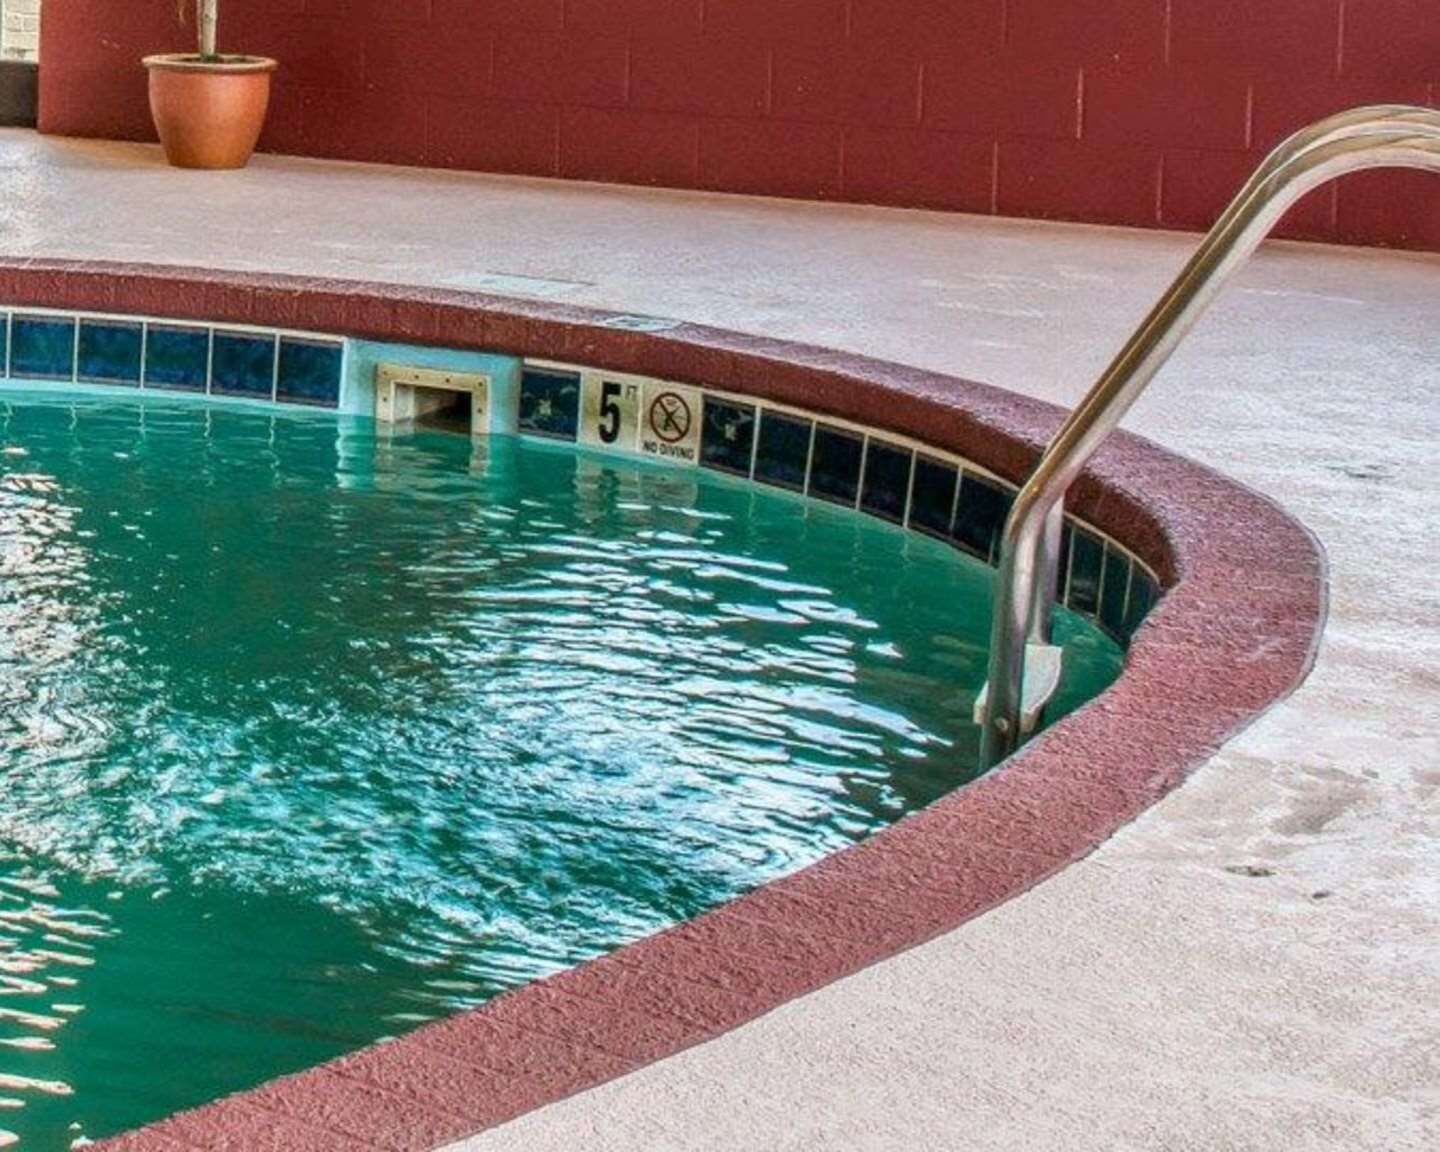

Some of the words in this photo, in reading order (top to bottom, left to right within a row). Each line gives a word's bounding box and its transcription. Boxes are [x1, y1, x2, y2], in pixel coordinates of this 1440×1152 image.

[598, 382, 622, 443] 5
[643, 440, 658, 454] NO
[660, 443, 696, 461] DIVING
